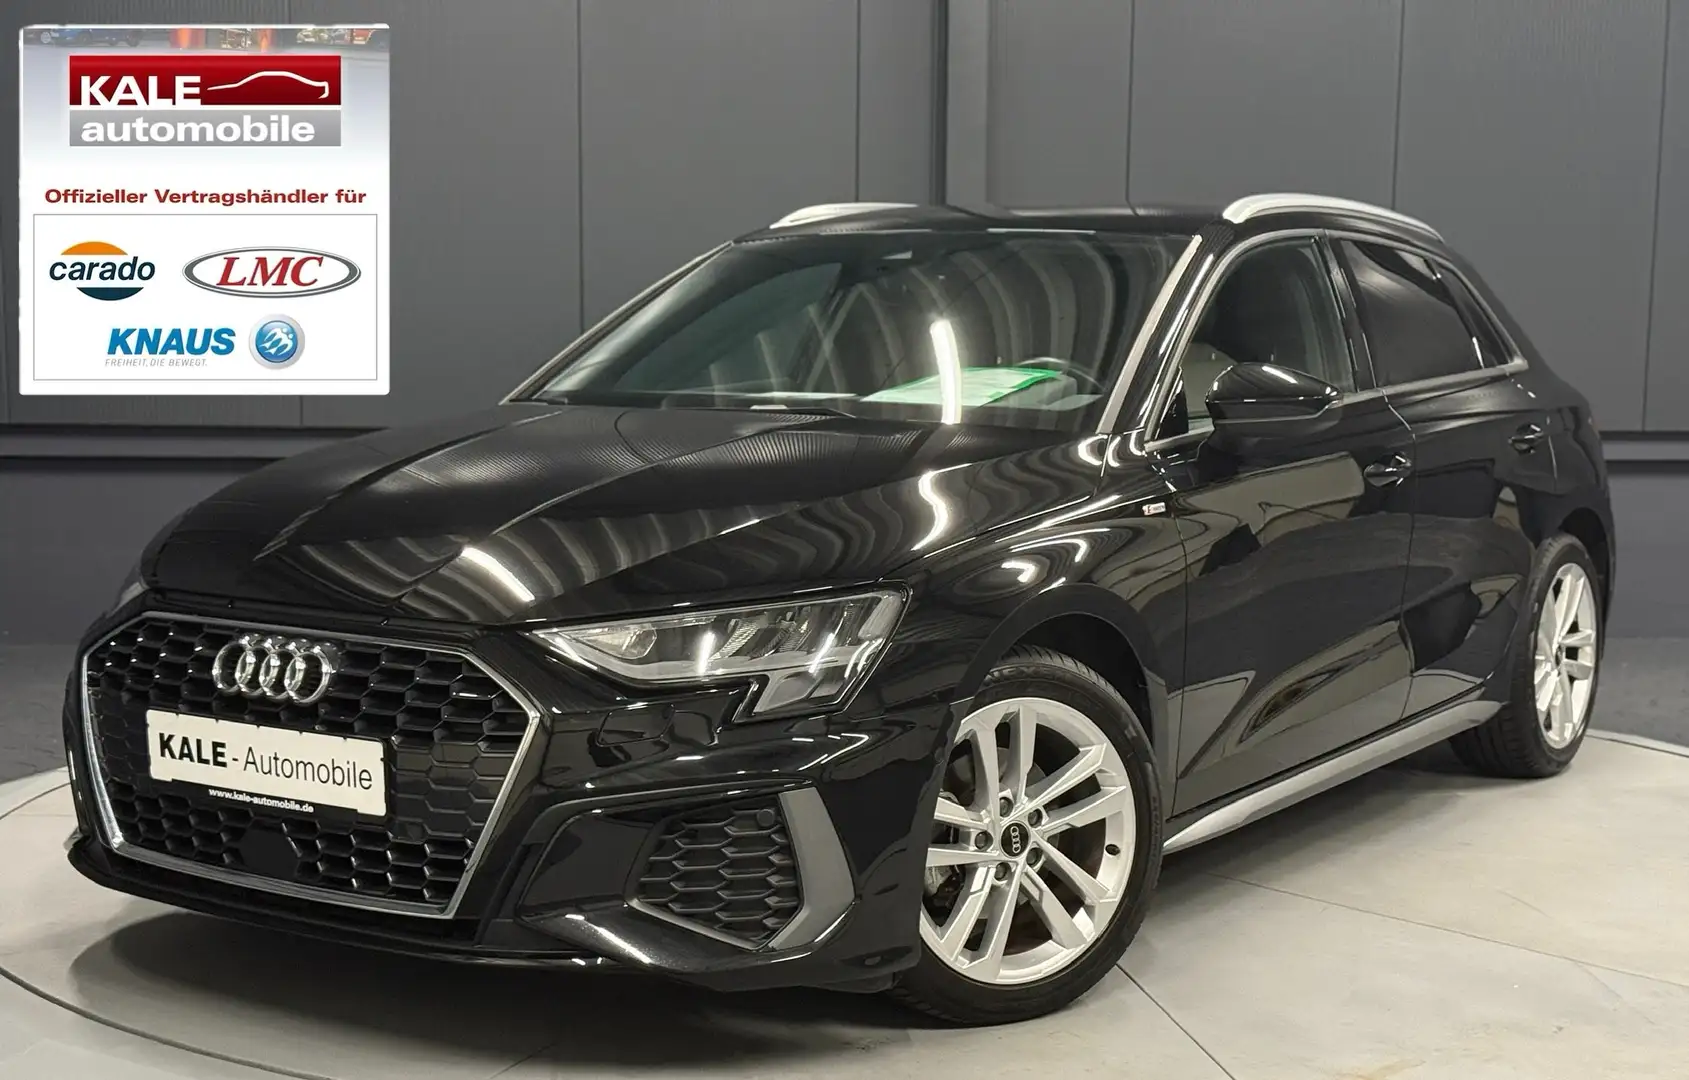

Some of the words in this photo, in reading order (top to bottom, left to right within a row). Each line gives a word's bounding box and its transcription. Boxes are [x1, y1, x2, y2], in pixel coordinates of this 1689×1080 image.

[158, 732, 228, 768] KALE
[243, 746, 373, 790] Automobile
[208, 788, 315, 813] www.kale-automobile.de
